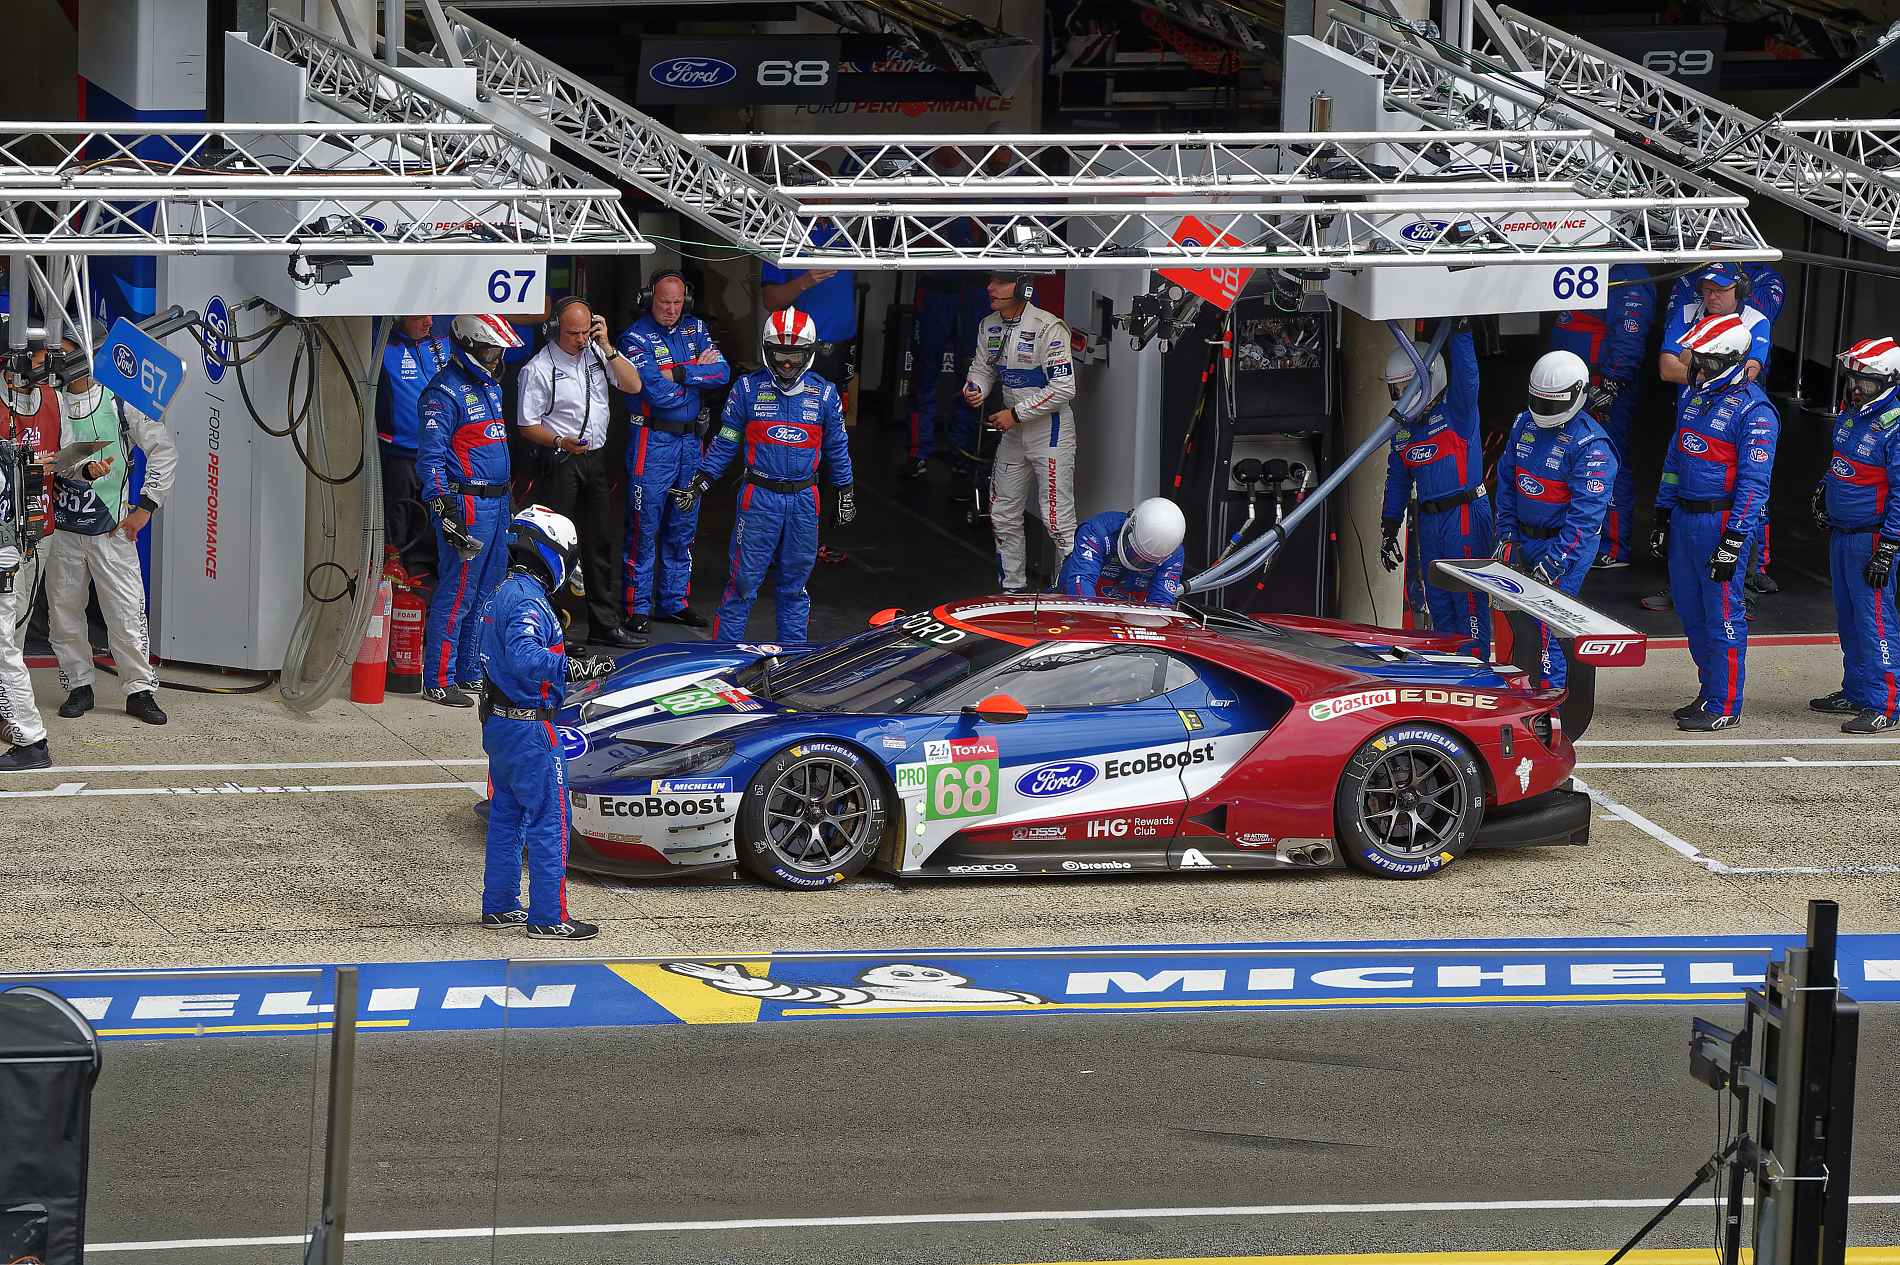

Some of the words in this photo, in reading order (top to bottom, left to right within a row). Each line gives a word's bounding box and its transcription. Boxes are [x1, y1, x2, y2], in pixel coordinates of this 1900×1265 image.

[665, 60, 719, 84] Ford
[756, 60, 831, 86] 68
[1642, 49, 1715, 76] 69
[1503, 218, 1587, 233] PERFORMNCE
[487, 268, 537, 304] 67
[1552, 265, 1600, 300] 68
[207, 311, 228, 368] Ford
[117, 346, 134, 376] Ford
[141, 358, 168, 401] 67
[208, 406, 221, 451] FORD
[775, 426, 803, 441] Ford
[1410, 447, 1433, 462] Ford
[1684, 433, 1702, 451] Ford
[634, 484, 643, 512] FORD
[1048, 457, 1057, 534] PERFORMANCE
[204, 452, 220, 580] PERFORMANCE
[902, 610, 967, 645] FORD
[1471, 615, 1480, 641] FORD
[1578, 639, 1645, 657] GT
[1879, 639, 1891, 665] FORD
[1331, 690, 1391, 714] Castrol
[1400, 689, 1499, 710] EDGE
[810, 743, 860, 763] MICHELIN
[928, 743, 949, 757] 24h
[952, 743, 995, 756] TOTAL
[1398, 730, 1460, 753] MICHELIN
[554, 756, 564, 785] FORD
[898, 766, 926, 787] PRO
[1031, 765, 1082, 794] Ford
[1104, 742, 1215, 780] EcoBoost
[673, 782, 726, 791] MICHELIN
[934, 763, 991, 816] 68
[599, 794, 726, 818] EcoBoost
[1086, 817, 1129, 838] IHG
[1134, 816, 1175, 827] Rewards
[1133, 827, 1157, 837] Club
[946, 862, 1018, 874] sparco
[1078, 859, 1132, 871] brembo
[1366, 851, 1432, 873] MICHELIN
[775, 868, 826, 886] MICHELIN
